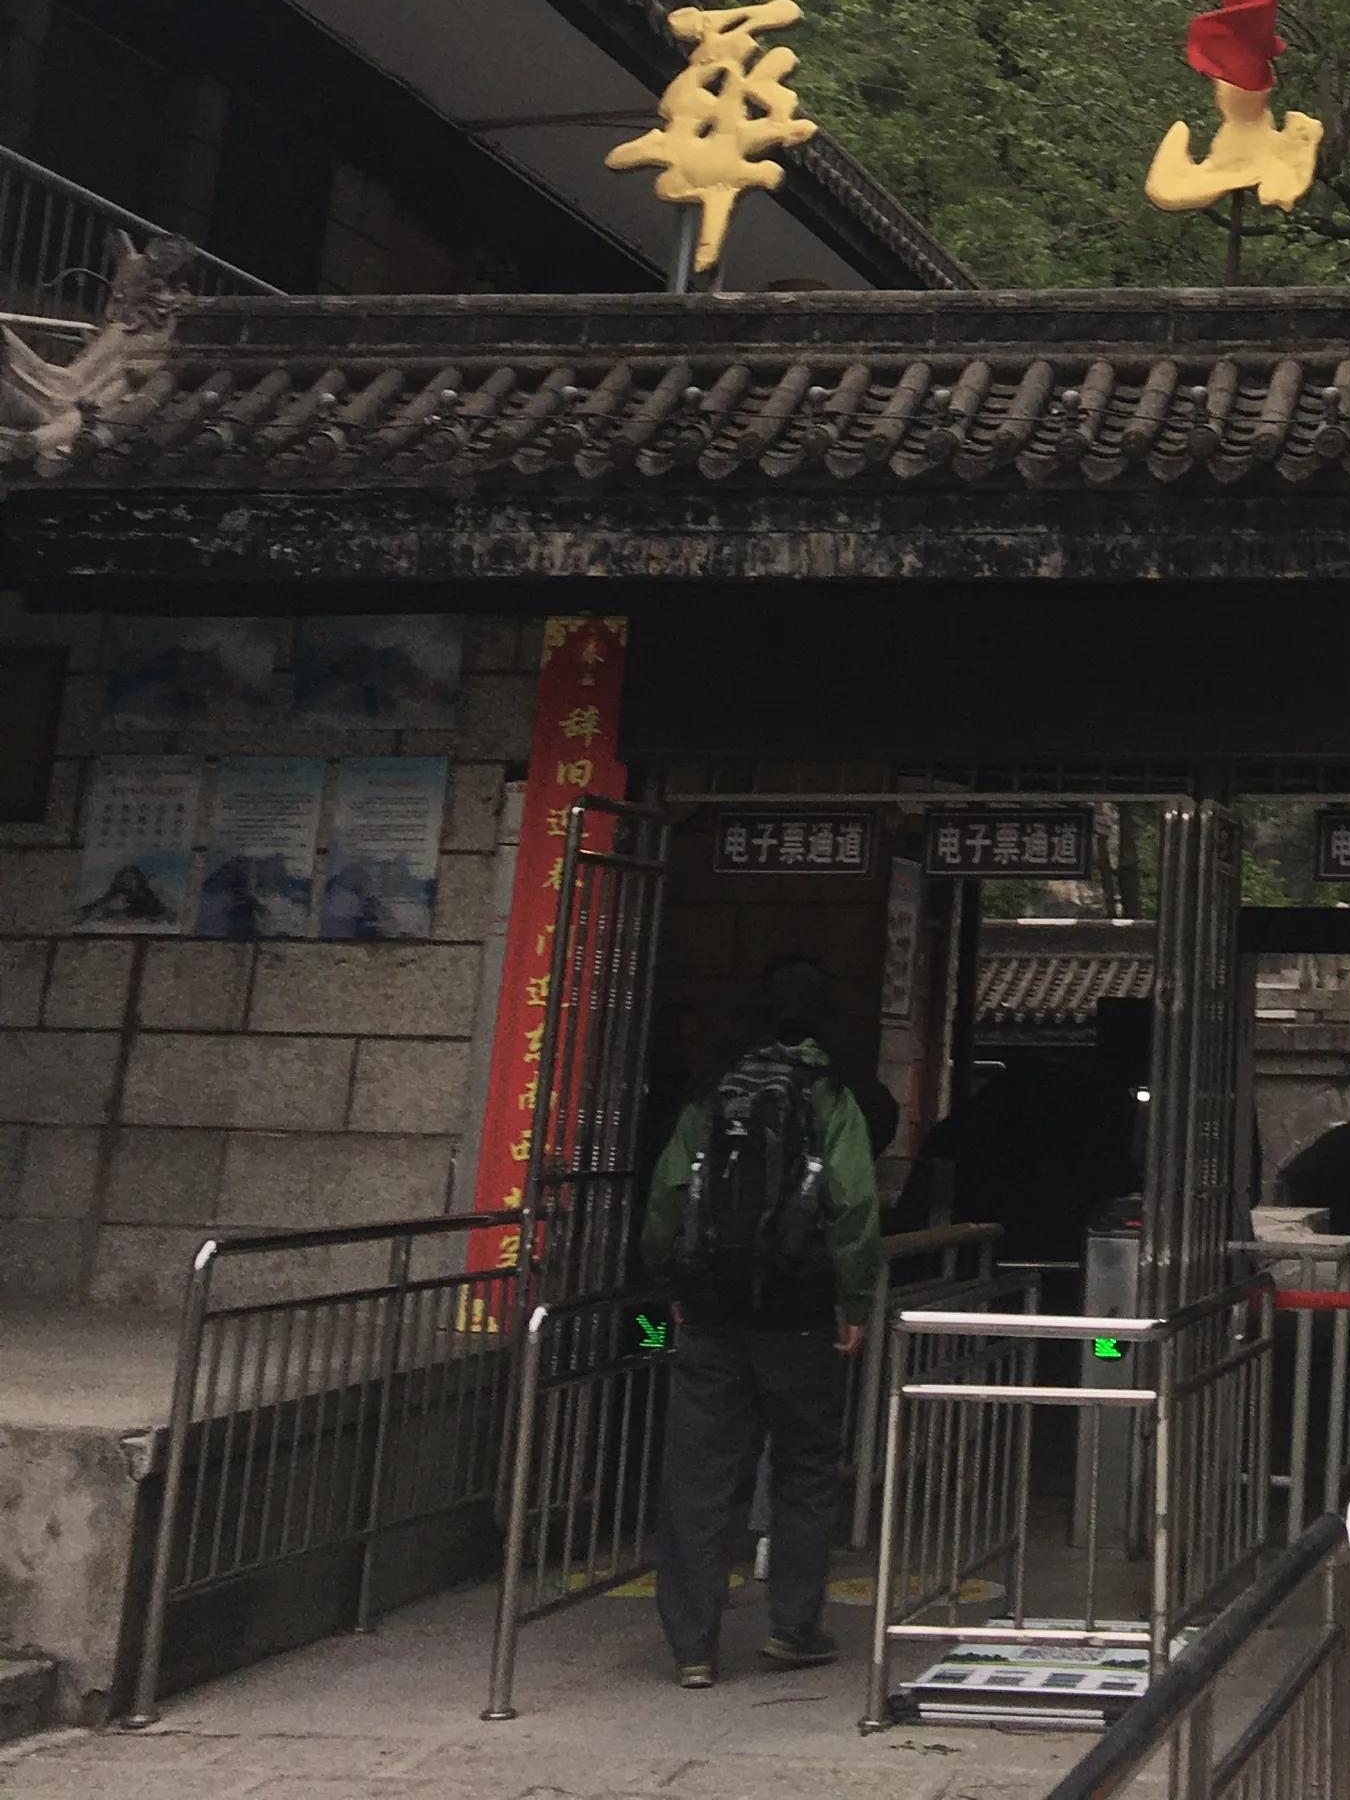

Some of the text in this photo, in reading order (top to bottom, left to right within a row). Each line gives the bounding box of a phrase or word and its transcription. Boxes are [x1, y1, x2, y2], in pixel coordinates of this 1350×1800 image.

[723, 823, 863, 868] 电子票通道
[936, 822, 1078, 869] 电子票通道
